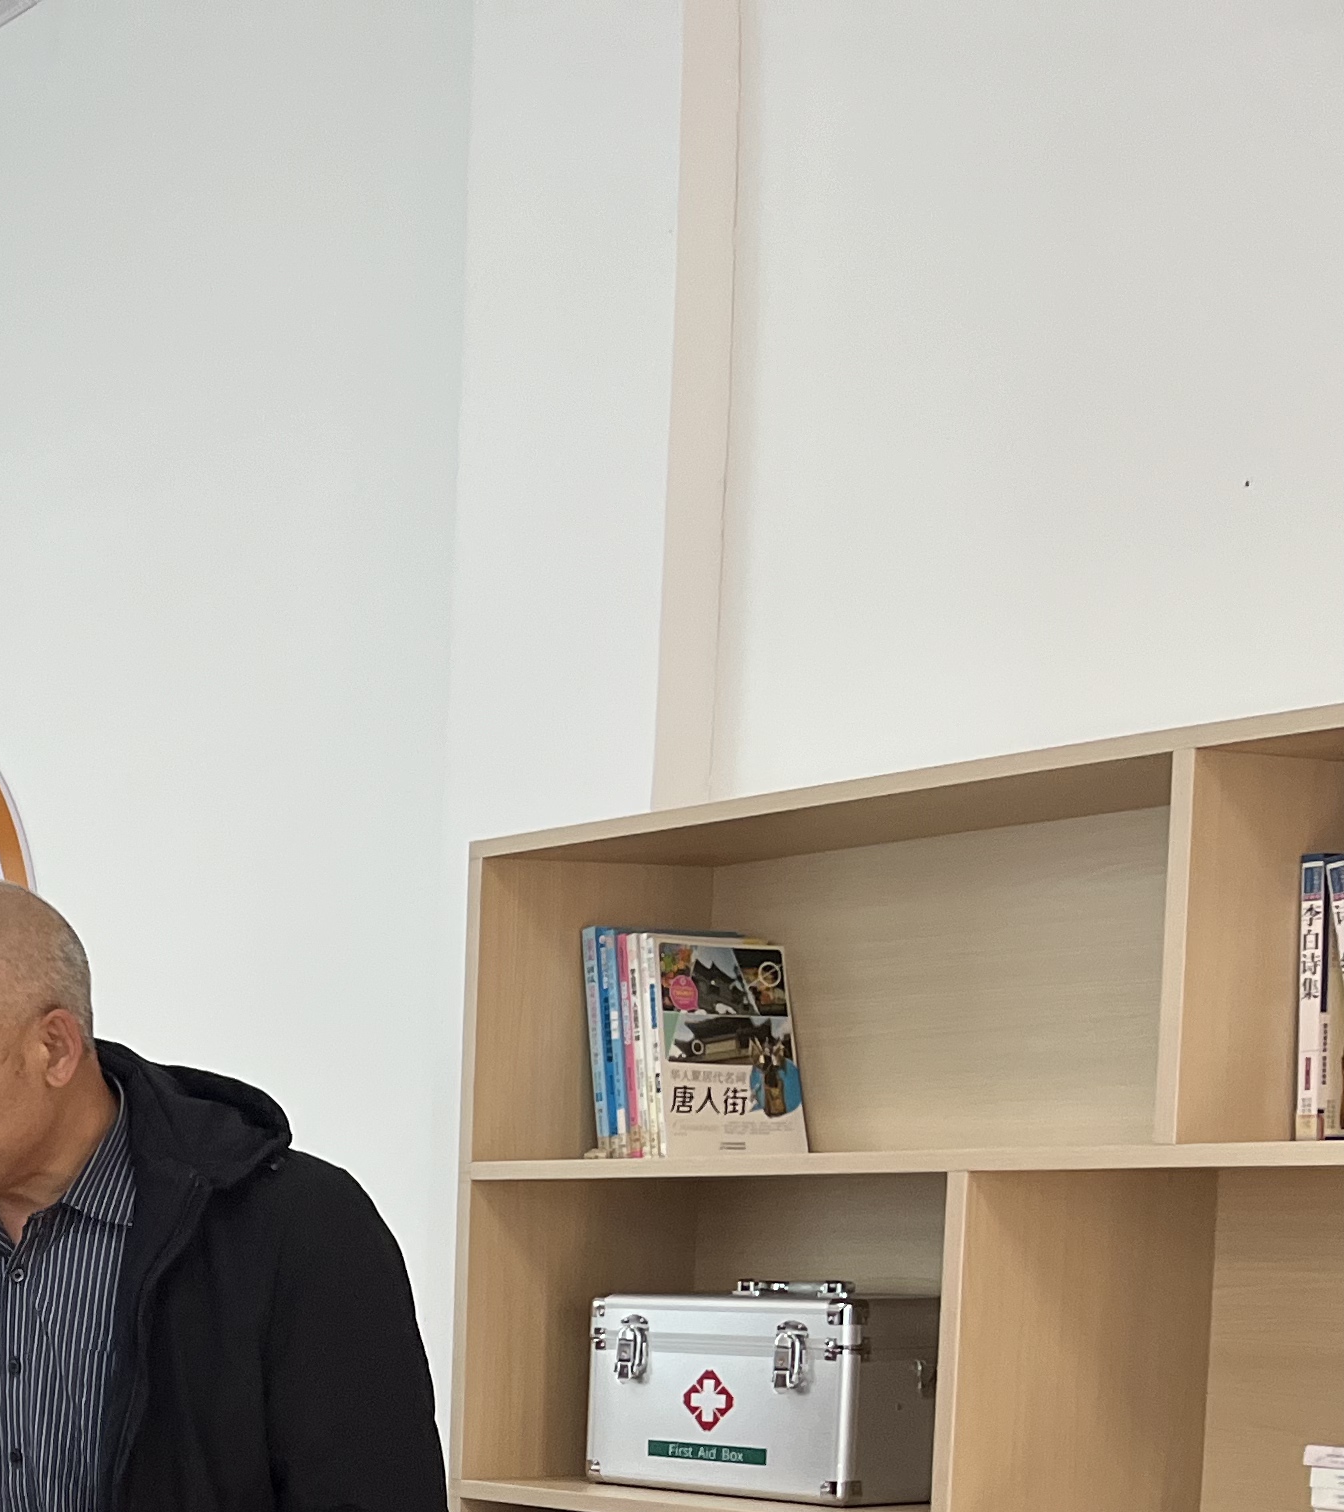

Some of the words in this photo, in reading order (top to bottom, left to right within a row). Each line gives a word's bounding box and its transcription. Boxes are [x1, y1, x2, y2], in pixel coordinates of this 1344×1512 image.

[1301, 903, 1322, 1001] 李白诗集
[670, 1085, 748, 1116] 唐人街
[668, 1443, 693, 1457] First
[697, 1446, 717, 1460] Aid
[721, 1448, 744, 1462] Box
